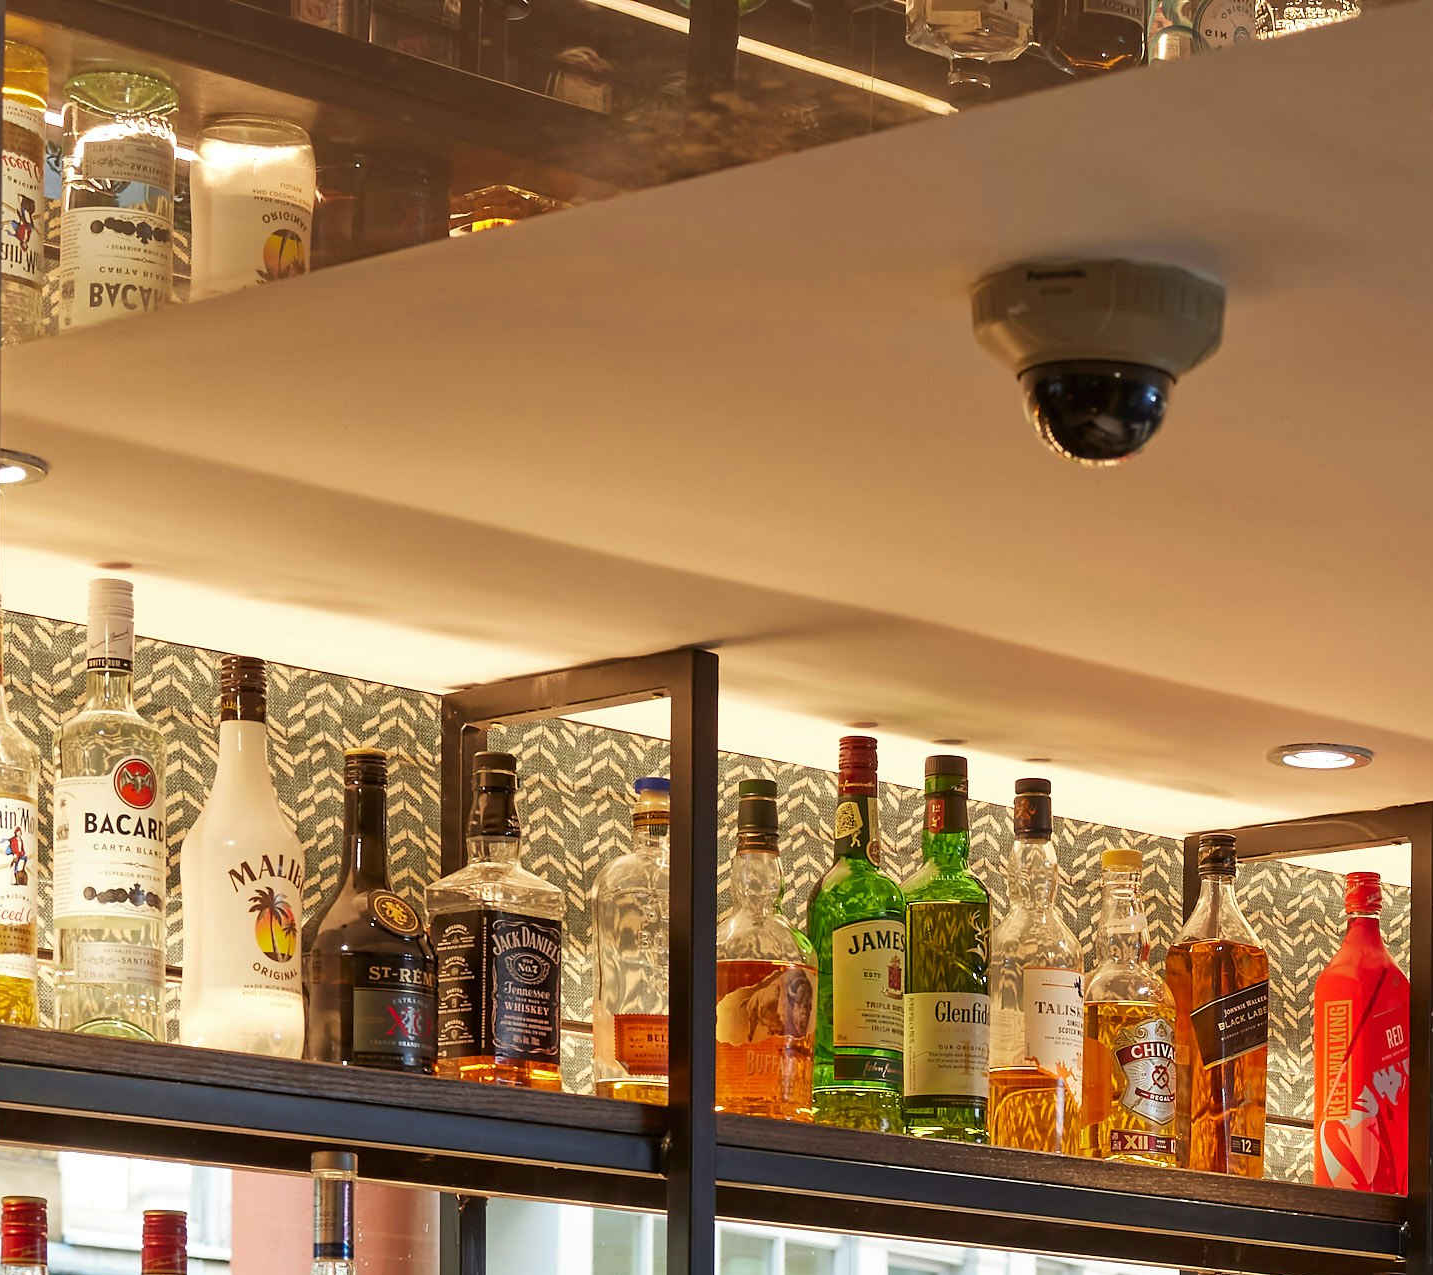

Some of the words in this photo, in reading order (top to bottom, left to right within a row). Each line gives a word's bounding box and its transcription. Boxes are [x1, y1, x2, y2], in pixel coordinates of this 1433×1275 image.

[84, 812, 164, 843] BACARD
[93, 844, 132, 853] CARTA
[492, 933, 522, 957] JACK
[521, 926, 562, 966] DANIEL'S
[252, 962, 298, 981] ORIGINAL
[504, 980, 551, 1000] Tennessee
[504, 1001, 550, 1017] WHISKEY
[1224, 1002, 1245, 1019] JOHNNIE
[1218, 1016, 1246, 1032] BLACK
[1328, 1003, 1349, 1075] WALKING
[1386, 1024, 1405, 1050] RED
[1150, 1093, 1171, 1102] REGAL
[1327, 1079, 1342, 1120] KEEP
[1124, 1134, 1149, 1150] XII
[1241, 1138, 1252, 1153] 12
